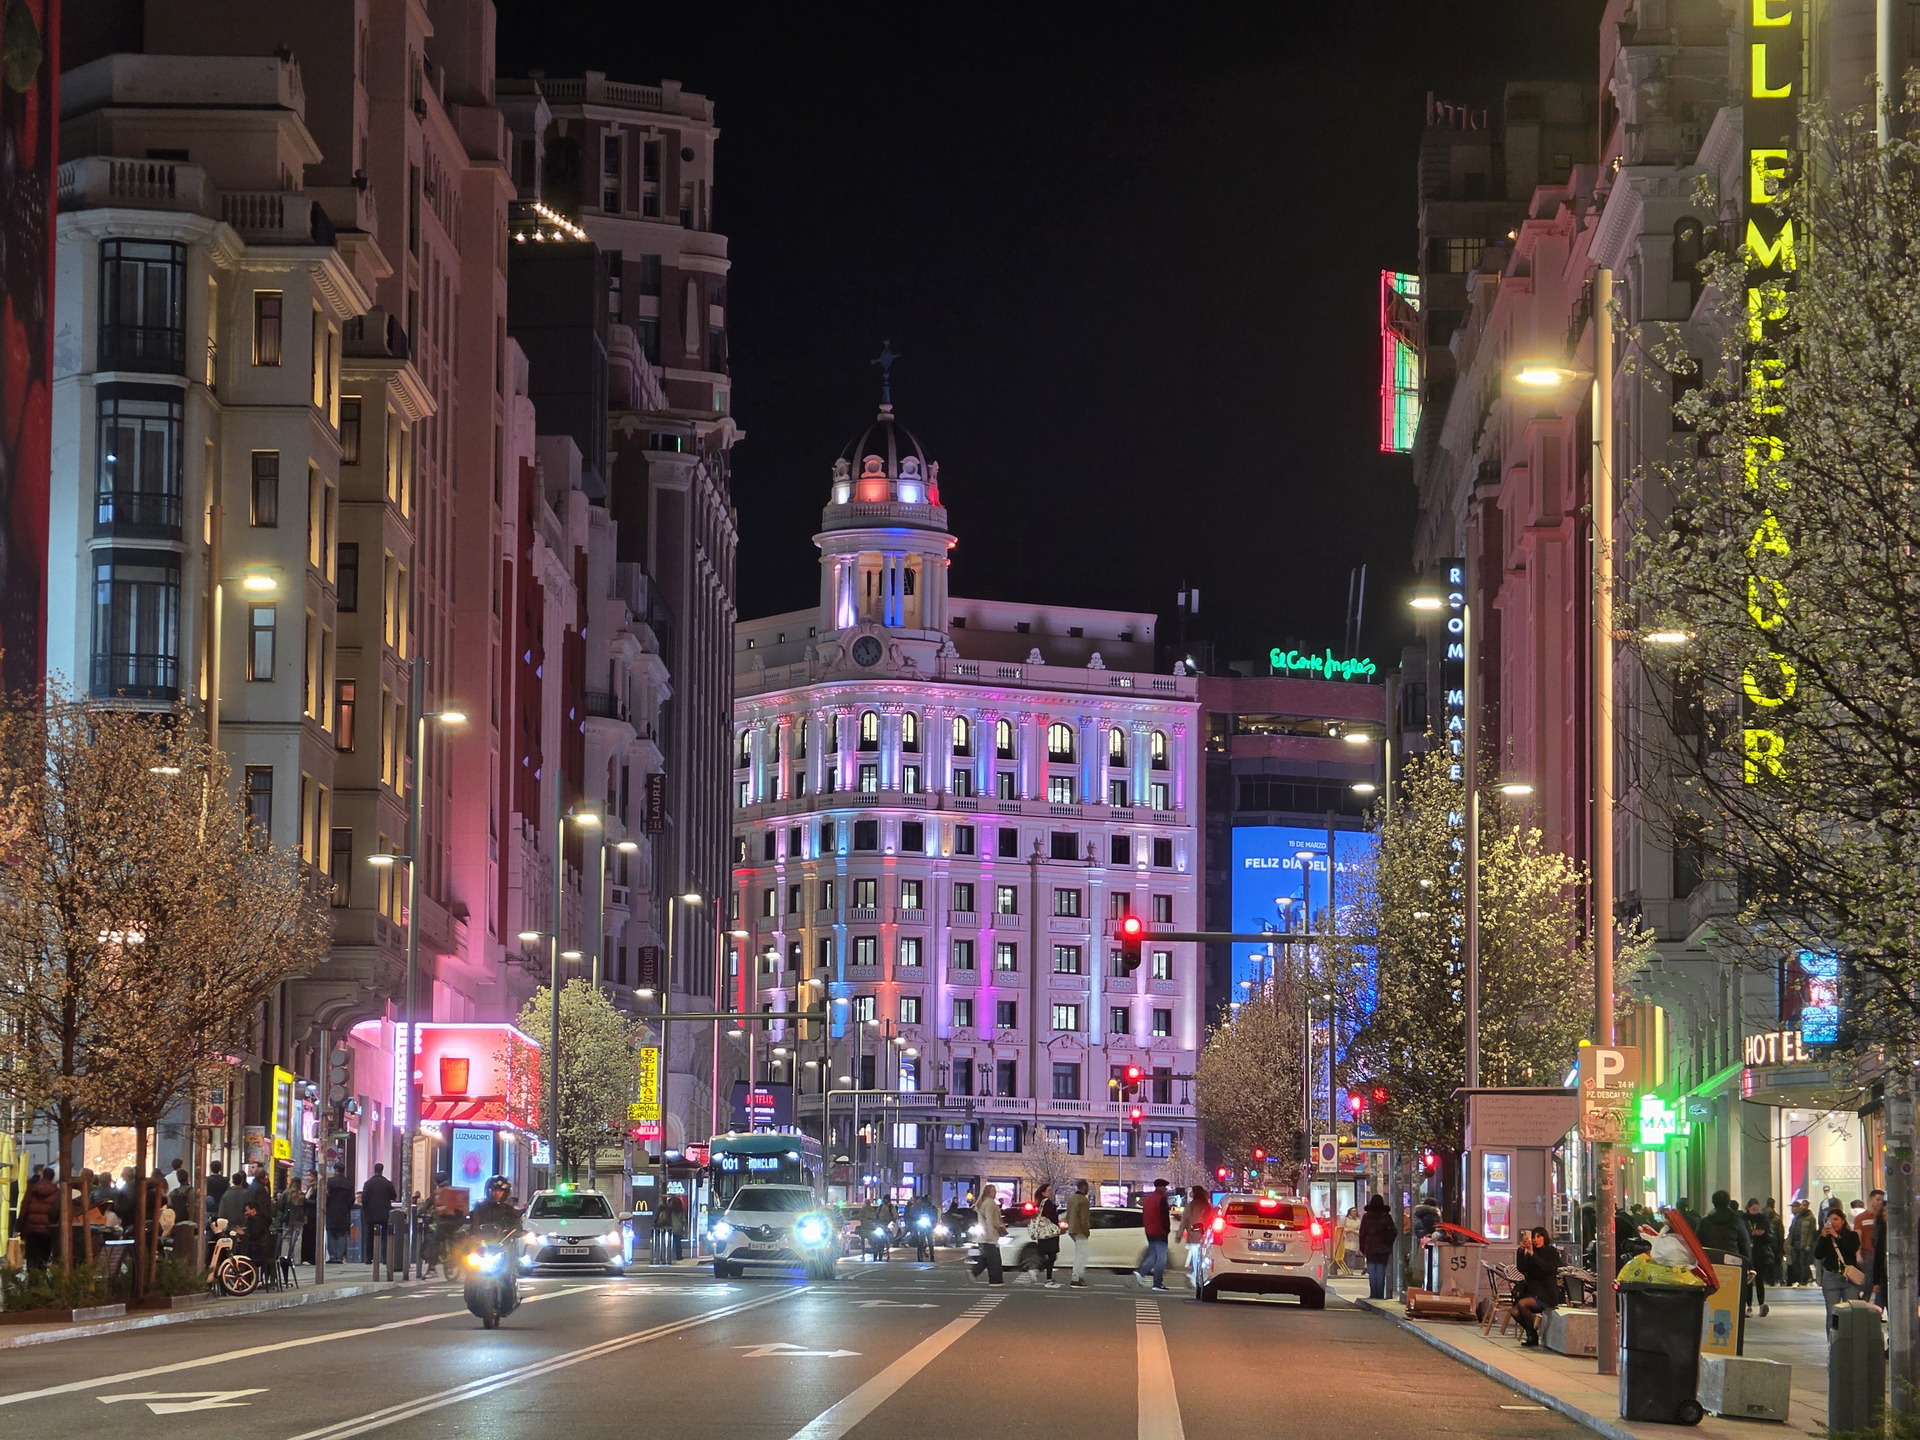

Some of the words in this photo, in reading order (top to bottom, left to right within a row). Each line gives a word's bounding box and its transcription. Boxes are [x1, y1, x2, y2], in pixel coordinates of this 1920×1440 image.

[1448, 567, 1464, 659] ROOM
[1270, 648, 1286, 668] El
[1287, 650, 1323, 671] Corte
[1324, 648, 1376, 680] Inglés
[1448, 689, 1464, 781] MATE
[652, 775, 661, 819] LAURIA
[1296, 840, 1304, 848] DE
[1305, 841, 1326, 849] MARZO
[1245, 857, 1279, 868] FELIZ
[1282, 857, 1302, 870] DÍA
[1744, 1031, 1809, 1065] HOTEL
[643, 1049, 654, 1102] PELUCAS
[1596, 1050, 1624, 1088] P
[746, 1095, 774, 1105] NTFLIX
[722, 1158, 738, 1170] 001
